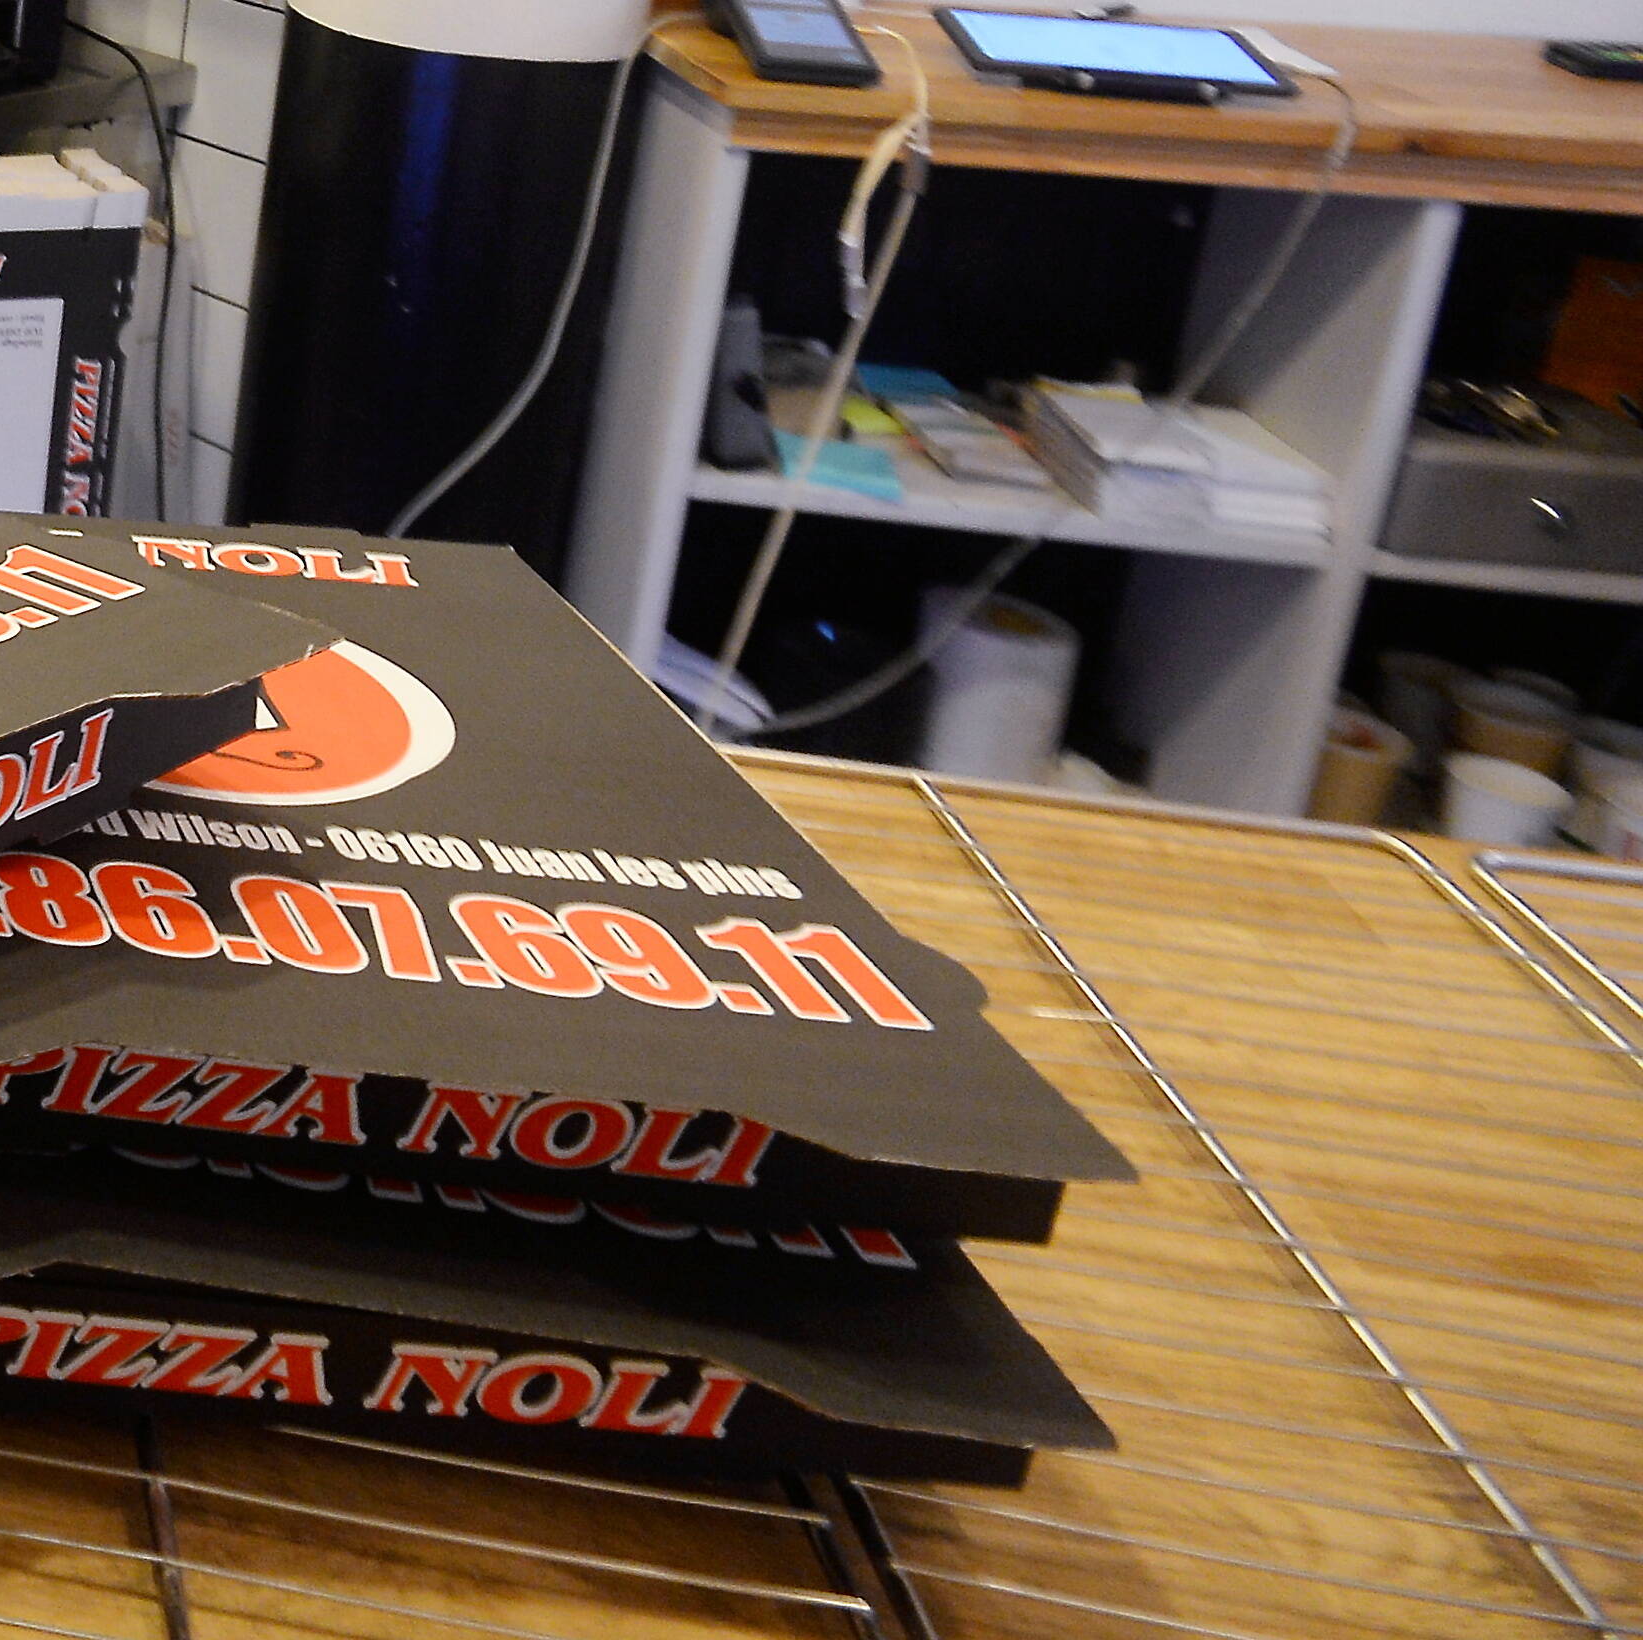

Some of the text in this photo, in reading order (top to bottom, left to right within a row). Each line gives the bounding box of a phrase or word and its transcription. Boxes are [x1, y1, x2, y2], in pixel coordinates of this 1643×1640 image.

[61, 356, 103, 517] PIZZA NO
[130, 534, 420, 588] NOLI
[117, 808, 302, 856] Wilson
[330, 825, 484, 873] 06160
[480, 837, 606, 883] Juan
[600, 847, 686, 890] les
[678, 854, 803, 901] pins
[397, 1080, 775, 1189] NOLI
[361, 1344, 751, 1440] NOLI
